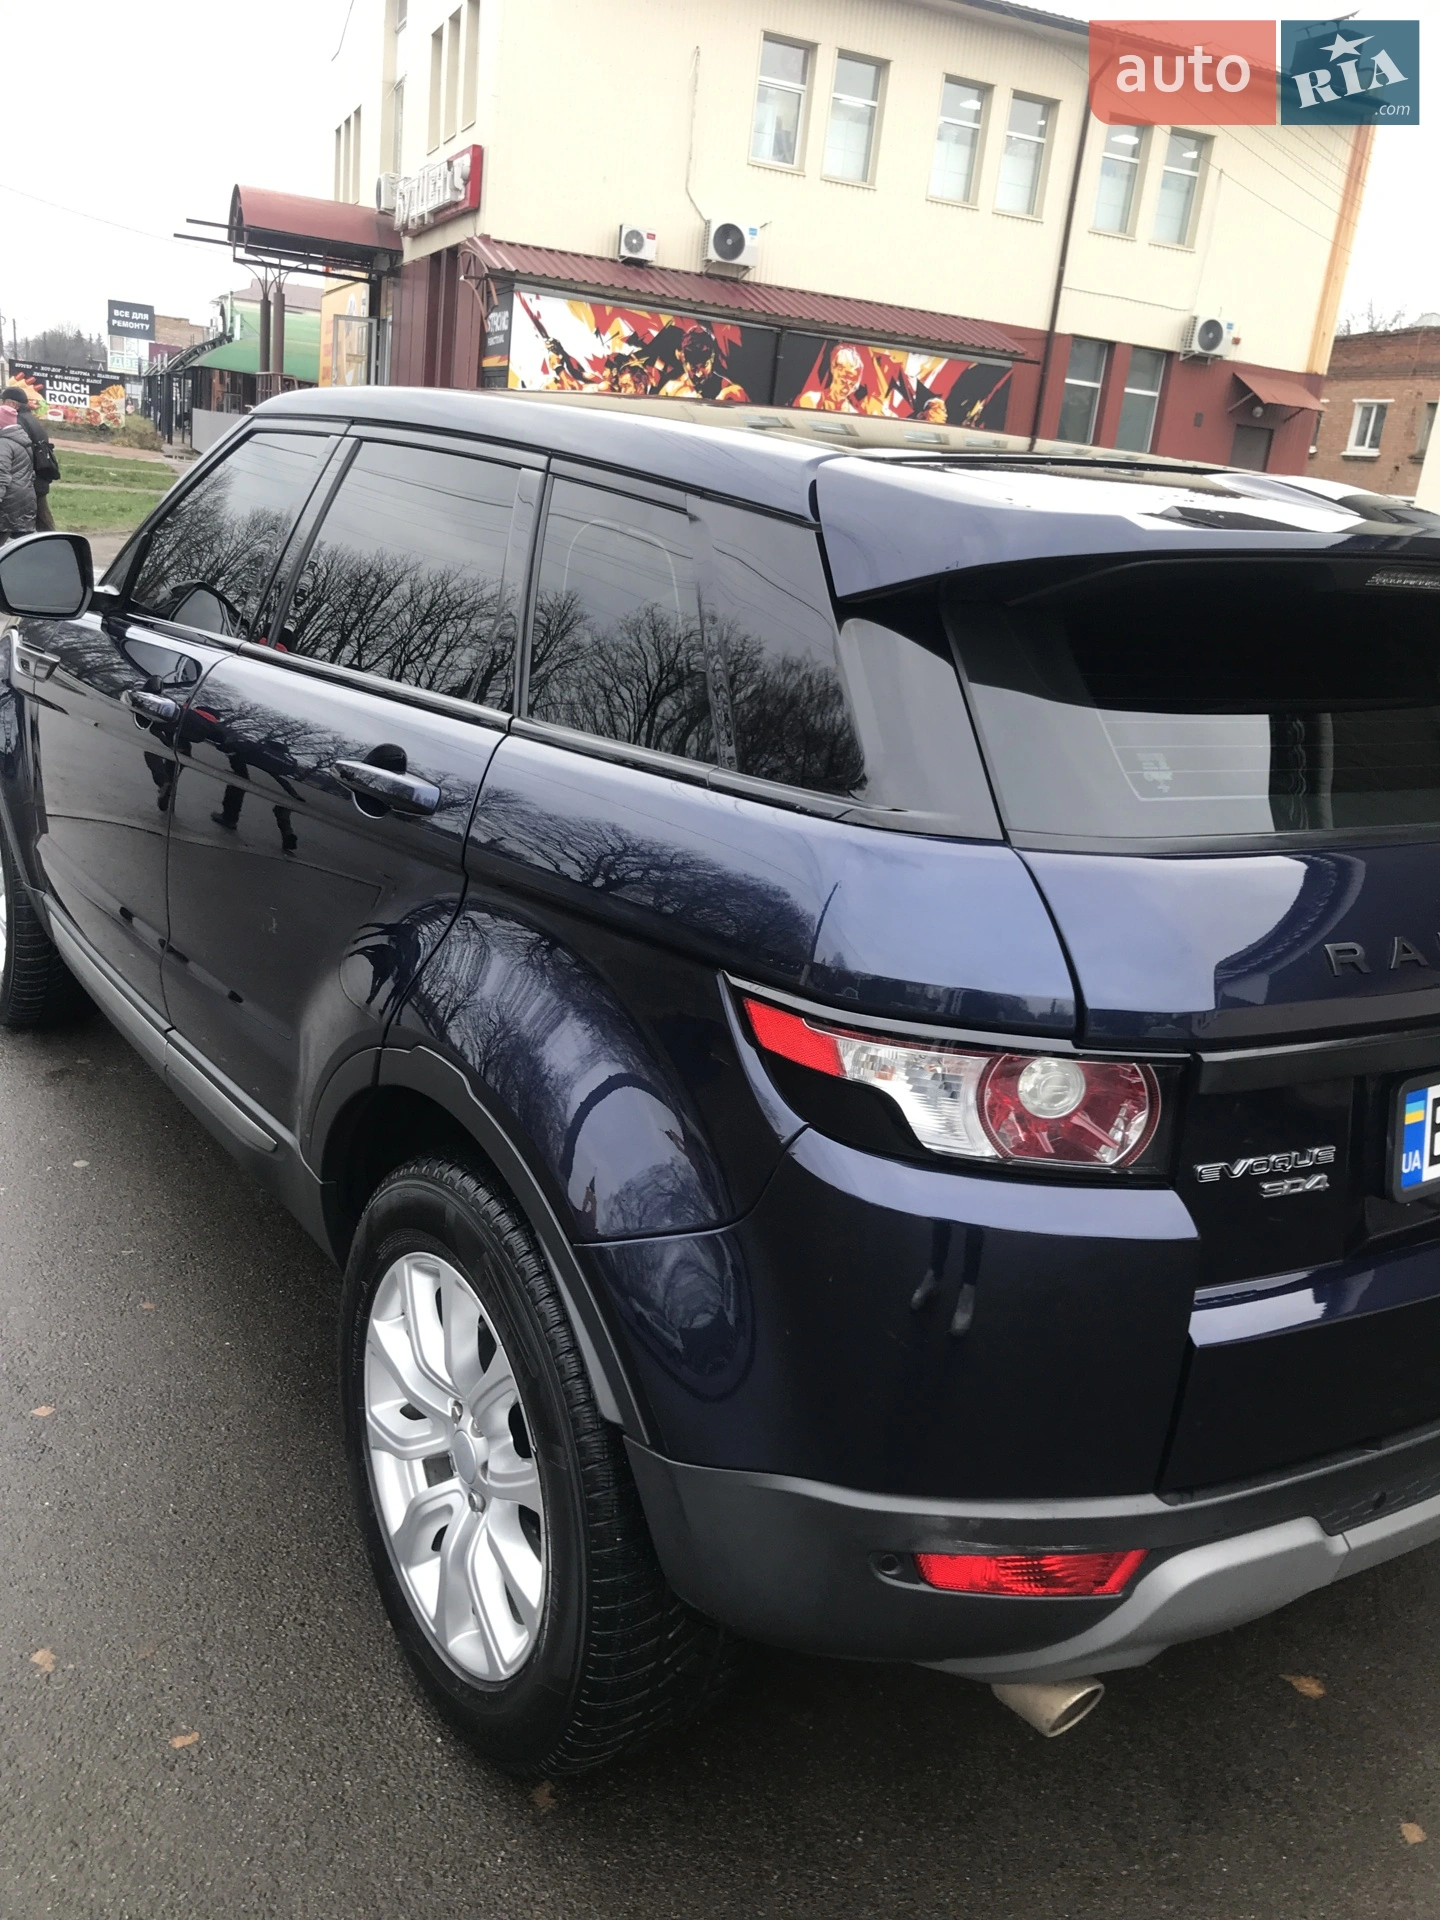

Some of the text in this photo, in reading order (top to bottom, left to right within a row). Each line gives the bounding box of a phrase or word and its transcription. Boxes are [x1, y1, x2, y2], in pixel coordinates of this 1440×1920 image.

[113, 309, 149, 320] ВСЕ ДЛЯ
[112, 319, 150, 330] РЕМОНТУ
[45, 380, 90, 394] LUNCH
[48, 393, 88, 406] ROOM
[1323, 931, 1440, 977] RA
[1194, 1145, 1336, 1182] EVOQUE
[1401, 1149, 1422, 1174] UA
[1260, 1173, 1330, 1198] SD4
